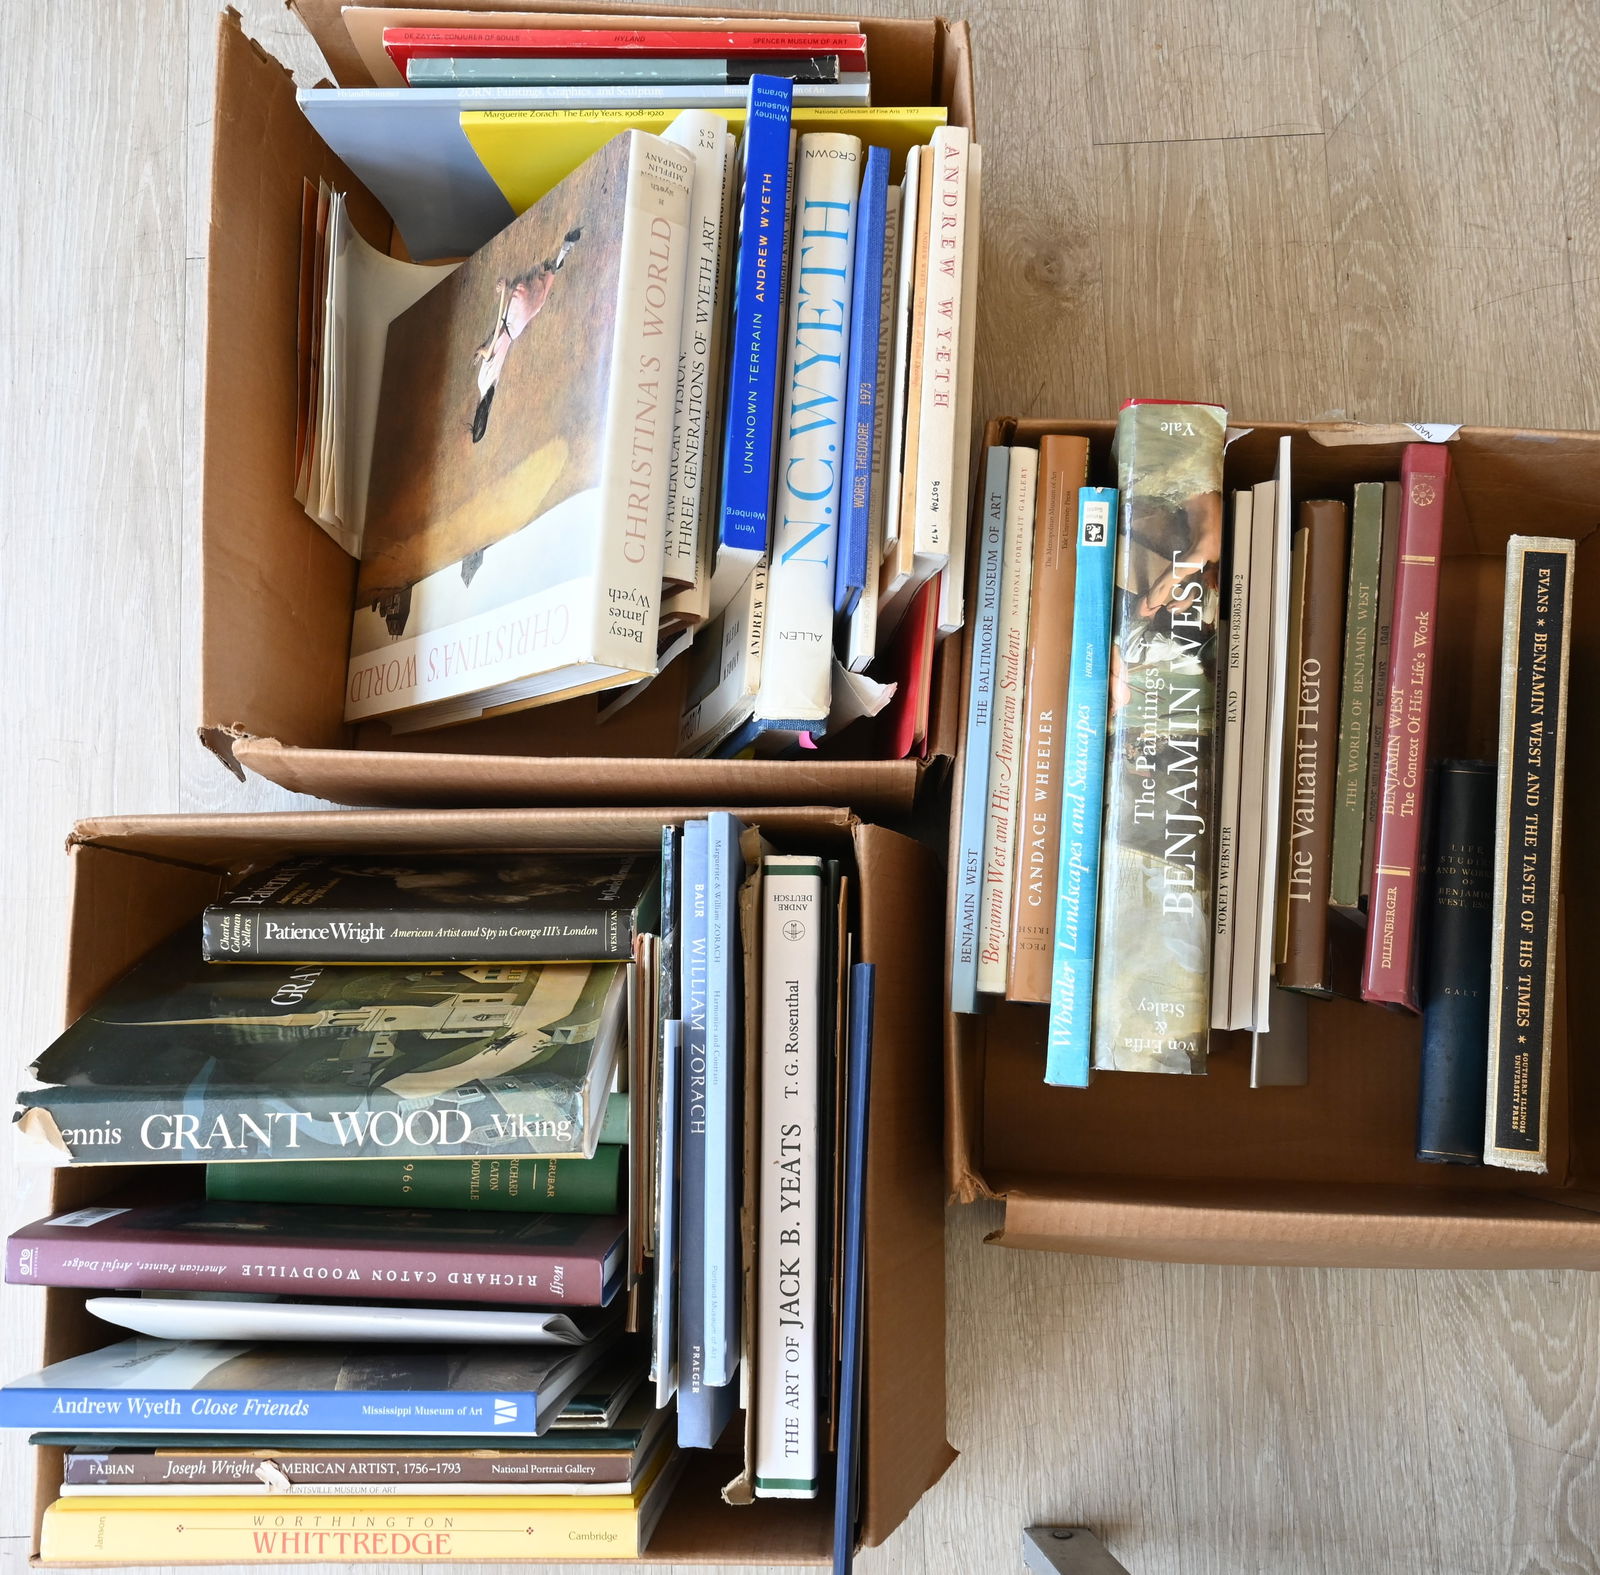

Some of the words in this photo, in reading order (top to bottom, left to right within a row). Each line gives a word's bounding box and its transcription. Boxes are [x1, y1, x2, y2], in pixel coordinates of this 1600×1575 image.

[614, 35, 646, 43] HYLAND
[753, 37, 785, 45] SPENCER
[754, 100, 789, 112] Museum
[757, 87, 788, 99] Abrams
[755, 110, 787, 122] Whitney
[806, 150, 857, 162] CROWN
[760, 174, 773, 227] WYETH
[941, 143, 961, 279] ANDREW
[702, 216, 716, 252] ART
[756, 235, 769, 302] ANDREW
[697, 257, 714, 327] WYETH
[694, 330, 708, 355] OF
[749, 312, 763, 383] TERRAIN
[934, 297, 954, 409] WYETH
[624, 355, 661, 564] CHRISTINA'S
[643, 217, 672, 338] WORLD
[684, 361, 705, 489] GENERATIONS
[744, 391, 758, 474] UNKNOWN
[1161, 421, 1196, 437] Yale
[726, 507, 766, 520] Weinberg
[991, 492, 1002, 519] ART
[678, 496, 695, 559] THREE
[735, 523, 755, 533] Venn
[989, 526, 1000, 542] OF
[1012, 567, 1022, 616] NATIONAL
[1020, 467, 1028, 512] GALLERY
[984, 550, 998, 609] MUSEUM
[1537, 568, 1551, 614] EVANS
[607, 587, 650, 609] Wyeth
[1171, 551, 1204, 674] WEST
[609, 608, 648, 625] James
[609, 621, 643, 643] Betsy
[1414, 611, 1429, 648] Work
[779, 631, 823, 643] ALLEN
[978, 615, 994, 692] BALTIMORE
[1000, 628, 1021, 692] Students
[1085, 642, 1094, 679] HOLDEN
[1411, 652, 1426, 685] Life's
[1531, 632, 1548, 716] BENJAMIN
[1227, 690, 1237, 723] RAND
[1298, 657, 1322, 723] Hero
[1408, 685, 1423, 712] His
[975, 700, 988, 726] THE
[1136, 668, 1165, 774] Paintings
[1388, 685, 1405, 732] WEST
[1407, 714, 1421, 734] Of
[999, 693, 1016, 782] American
[1034, 709, 1052, 802] WHEELER
[1074, 703, 1098, 790] Seascapes
[1528, 721, 1543, 767] WEST
[1382, 734, 1402, 816] BENJAMIN
[1404, 737, 1420, 793] Context
[991, 784, 1011, 811] His
[1134, 778, 1154, 824] The
[1163, 686, 1205, 917] BENJAMIN
[1293, 738, 1318, 843] Valiant
[1400, 795, 1414, 817] The
[1526, 772, 1541, 807] AND
[997, 816, 1009, 839] and
[1073, 796, 1086, 833] and
[1524, 813, 1539, 848] THE
[965, 848, 978, 886] WEST
[987, 842, 1007, 884] West
[1028, 812, 1047, 906] CANDACE
[1219, 826, 1232, 879] WEBSTER
[1289, 850, 1314, 903] The
[1522, 853, 1537, 904] TASTE
[694, 884, 705, 918] BAUR
[773, 894, 813, 902] DEUTSCH
[778, 903, 808, 911] ANDRE
[1059, 841, 1091, 952] Landscapes
[1217, 881, 1228, 934] STOKELY
[219, 915, 230, 951] Charles
[230, 912, 242, 953] Coleman
[241, 917, 252, 948] Sellers
[264, 922, 329, 941] Patience
[329, 922, 386, 944] Wright
[390, 928, 434, 938] American
[435, 927, 460, 938] Artist
[461, 927, 480, 938] and
[481, 927, 497, 941] Spy
[498, 927, 508, 938] in
[510, 926, 541, 941] George
[542, 926, 561, 937] III's
[562, 925, 598, 937] London
[610, 909, 618, 953] WESLEYAN
[960, 893, 976, 964] BENJAMIN
[981, 890, 1005, 965] Benjamin
[1381, 886, 1398, 969] DILLENBERGER
[1521, 910, 1534, 933] OF
[1519, 940, 1533, 969] HIS
[690, 937, 706, 1030] WILLIAM
[1516, 974, 1530, 1028] TIMES
[785, 979, 799, 1053] Rosenthal
[1054, 961, 1077, 1047] Whistler
[1137, 998, 1185, 1017] Staley
[1125, 1036, 1162, 1053] Erffa
[1168, 1039, 1195, 1051] von
[785, 1058, 799, 1078] G.
[1512, 1055, 1521, 1105] UNIVERSITY
[1521, 1052, 1529, 1089] SOUTHERN
[690, 1044, 706, 1135] ZORACH
[785, 1081, 799, 1099] T.
[62, 1120, 122, 1146] ennis
[140, 1112, 313, 1151] GRANT
[330, 1110, 472, 1147] WOOD
[490, 1113, 572, 1141] Viking
[1511, 1105, 1519, 1130] PRESS
[1519, 1092, 1528, 1133] ILLINOIS
[780, 1123, 802, 1213] YEATS
[780, 1221, 801, 1246] B.
[62, 1258, 98, 1271] Dodger
[100, 1259, 133, 1271] Artful
[136, 1261, 177, 1273] Painter,
[179, 1264, 227, 1275] American
[241, 1264, 360, 1281] WOODVILLE
[372, 1269, 437, 1283] CATON
[447, 1272, 537, 1286] RICHARD
[549, 1265, 564, 1298] Wolff
[779, 1257, 804, 1329] JACK
[785, 1336, 800, 1363] OF
[692, 1345, 701, 1394] PRAEGER
[52, 1396, 121, 1415] Andrew
[127, 1397, 181, 1419] Wyeth
[190, 1397, 238, 1416] Close
[242, 1398, 310, 1417] Friends
[785, 1369, 799, 1410] ART
[362, 1405, 412, 1417] Mississippi
[414, 1406, 455, 1416] Museum
[456, 1405, 467, 1416] of
[468, 1406, 483, 1416] Art
[785, 1418, 799, 1458] THE
[89, 1463, 135, 1475] FABIAN
[163, 1460, 207, 1479] Joseph
[211, 1460, 254, 1478] Wright
[281, 1463, 346, 1475] MERICAN
[349, 1463, 400, 1476] ARTIST,
[403, 1462, 462, 1475] 1756–1793
[491, 1464, 529, 1475] National
[531, 1464, 563, 1475] Portrait
[565, 1464, 596, 1478] Gallery
[253, 1515, 455, 1529] WORTHINGTON
[568, 1530, 618, 1542] Cambridge
[253, 1531, 453, 1556] WHITTREDGE
